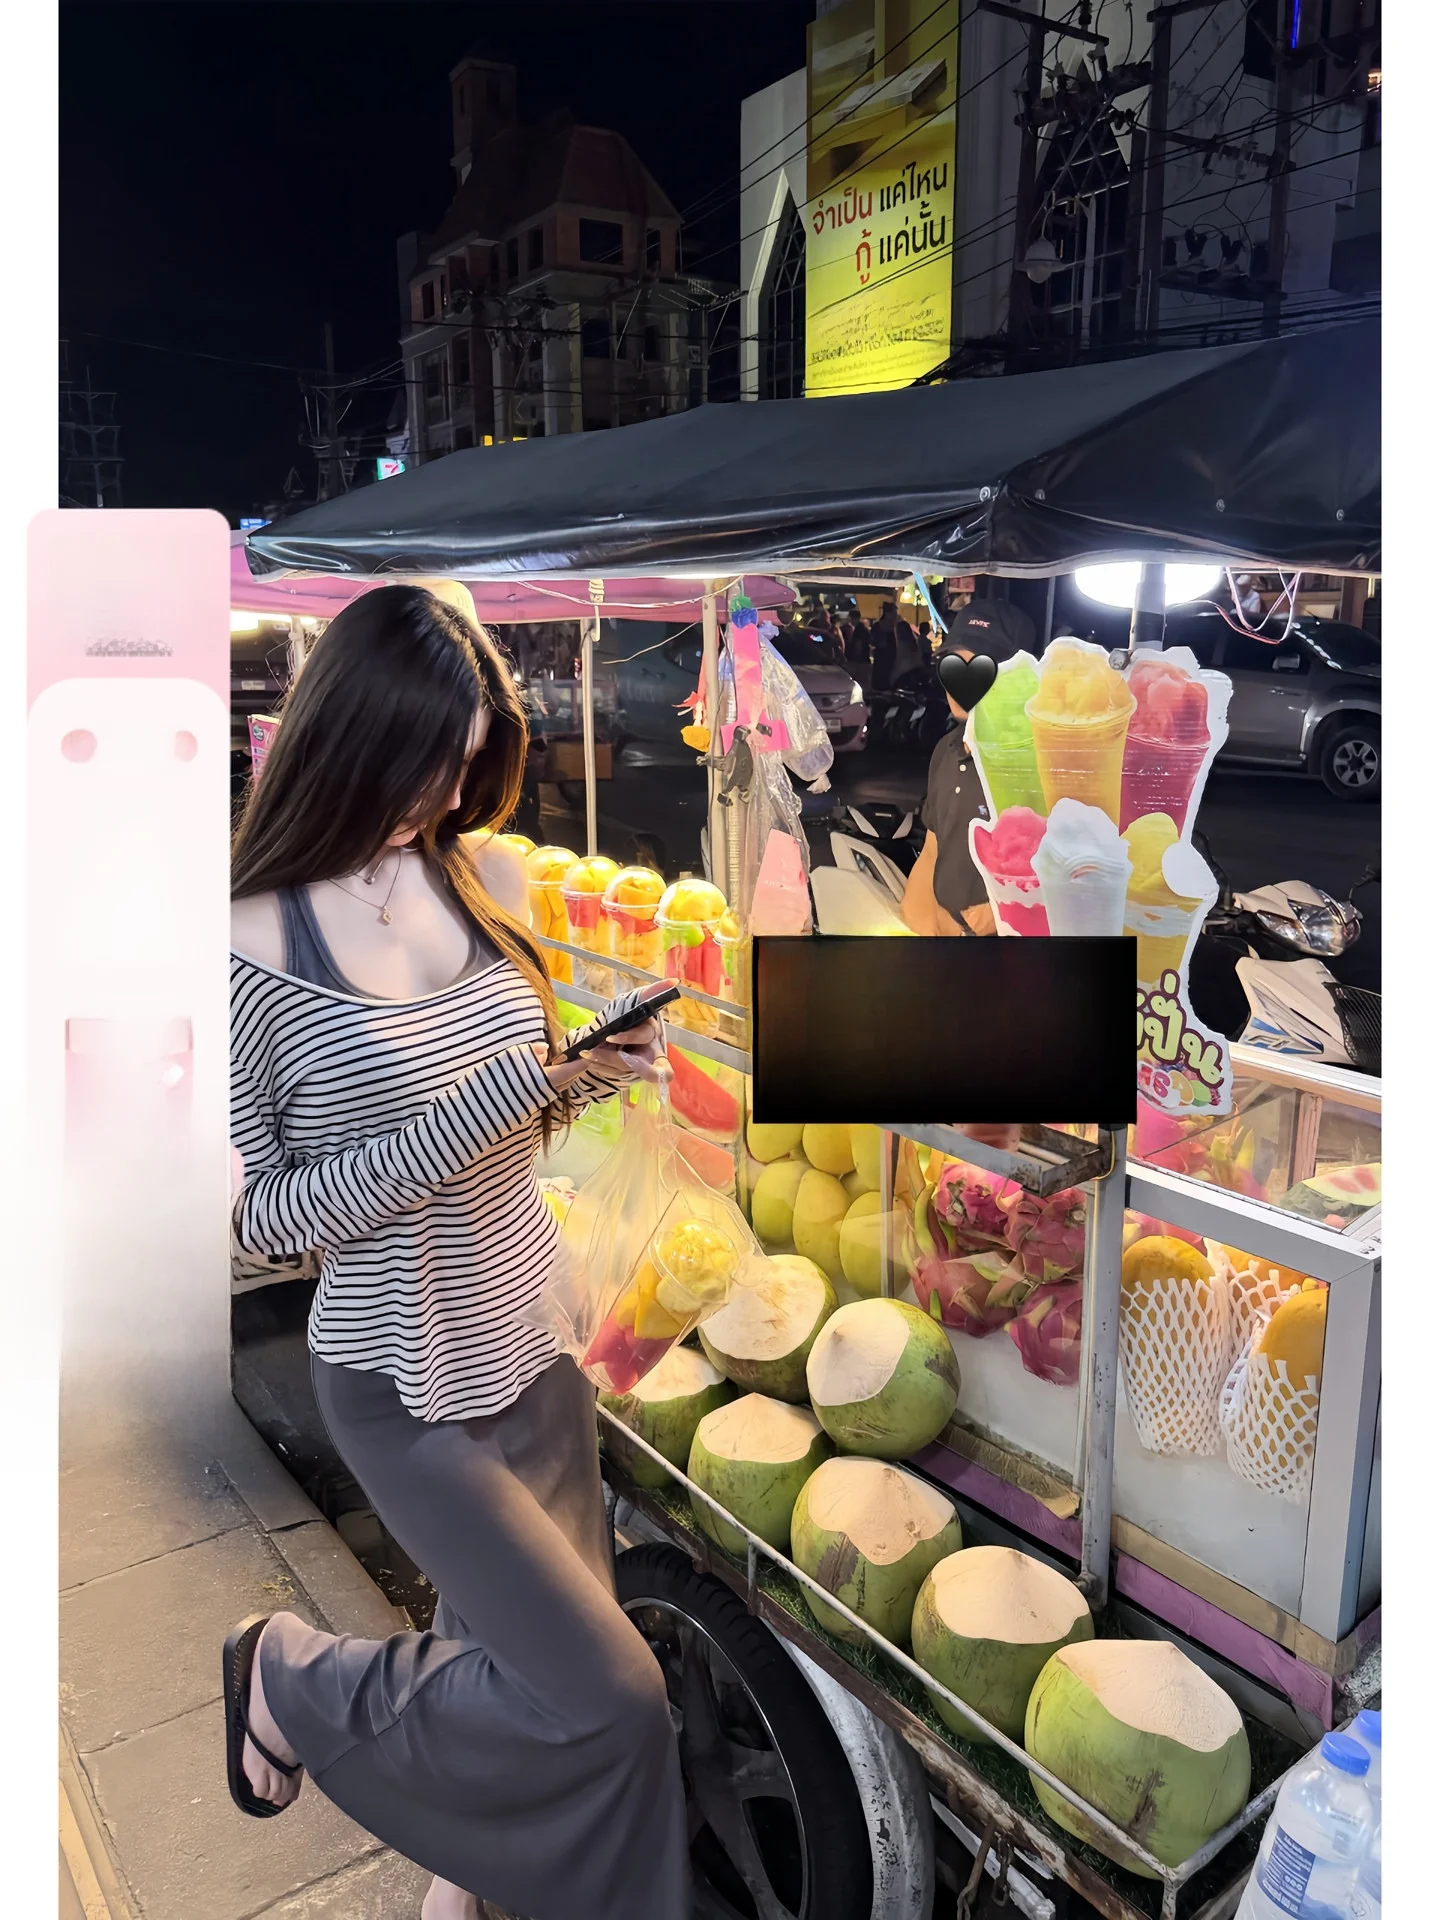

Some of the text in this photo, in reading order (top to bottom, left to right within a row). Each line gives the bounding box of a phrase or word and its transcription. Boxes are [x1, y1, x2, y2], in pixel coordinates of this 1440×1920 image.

[812, 161, 948, 235] จำเป็น แค่ไหน
[855, 201, 946, 285] กู้ แค่นั้น
